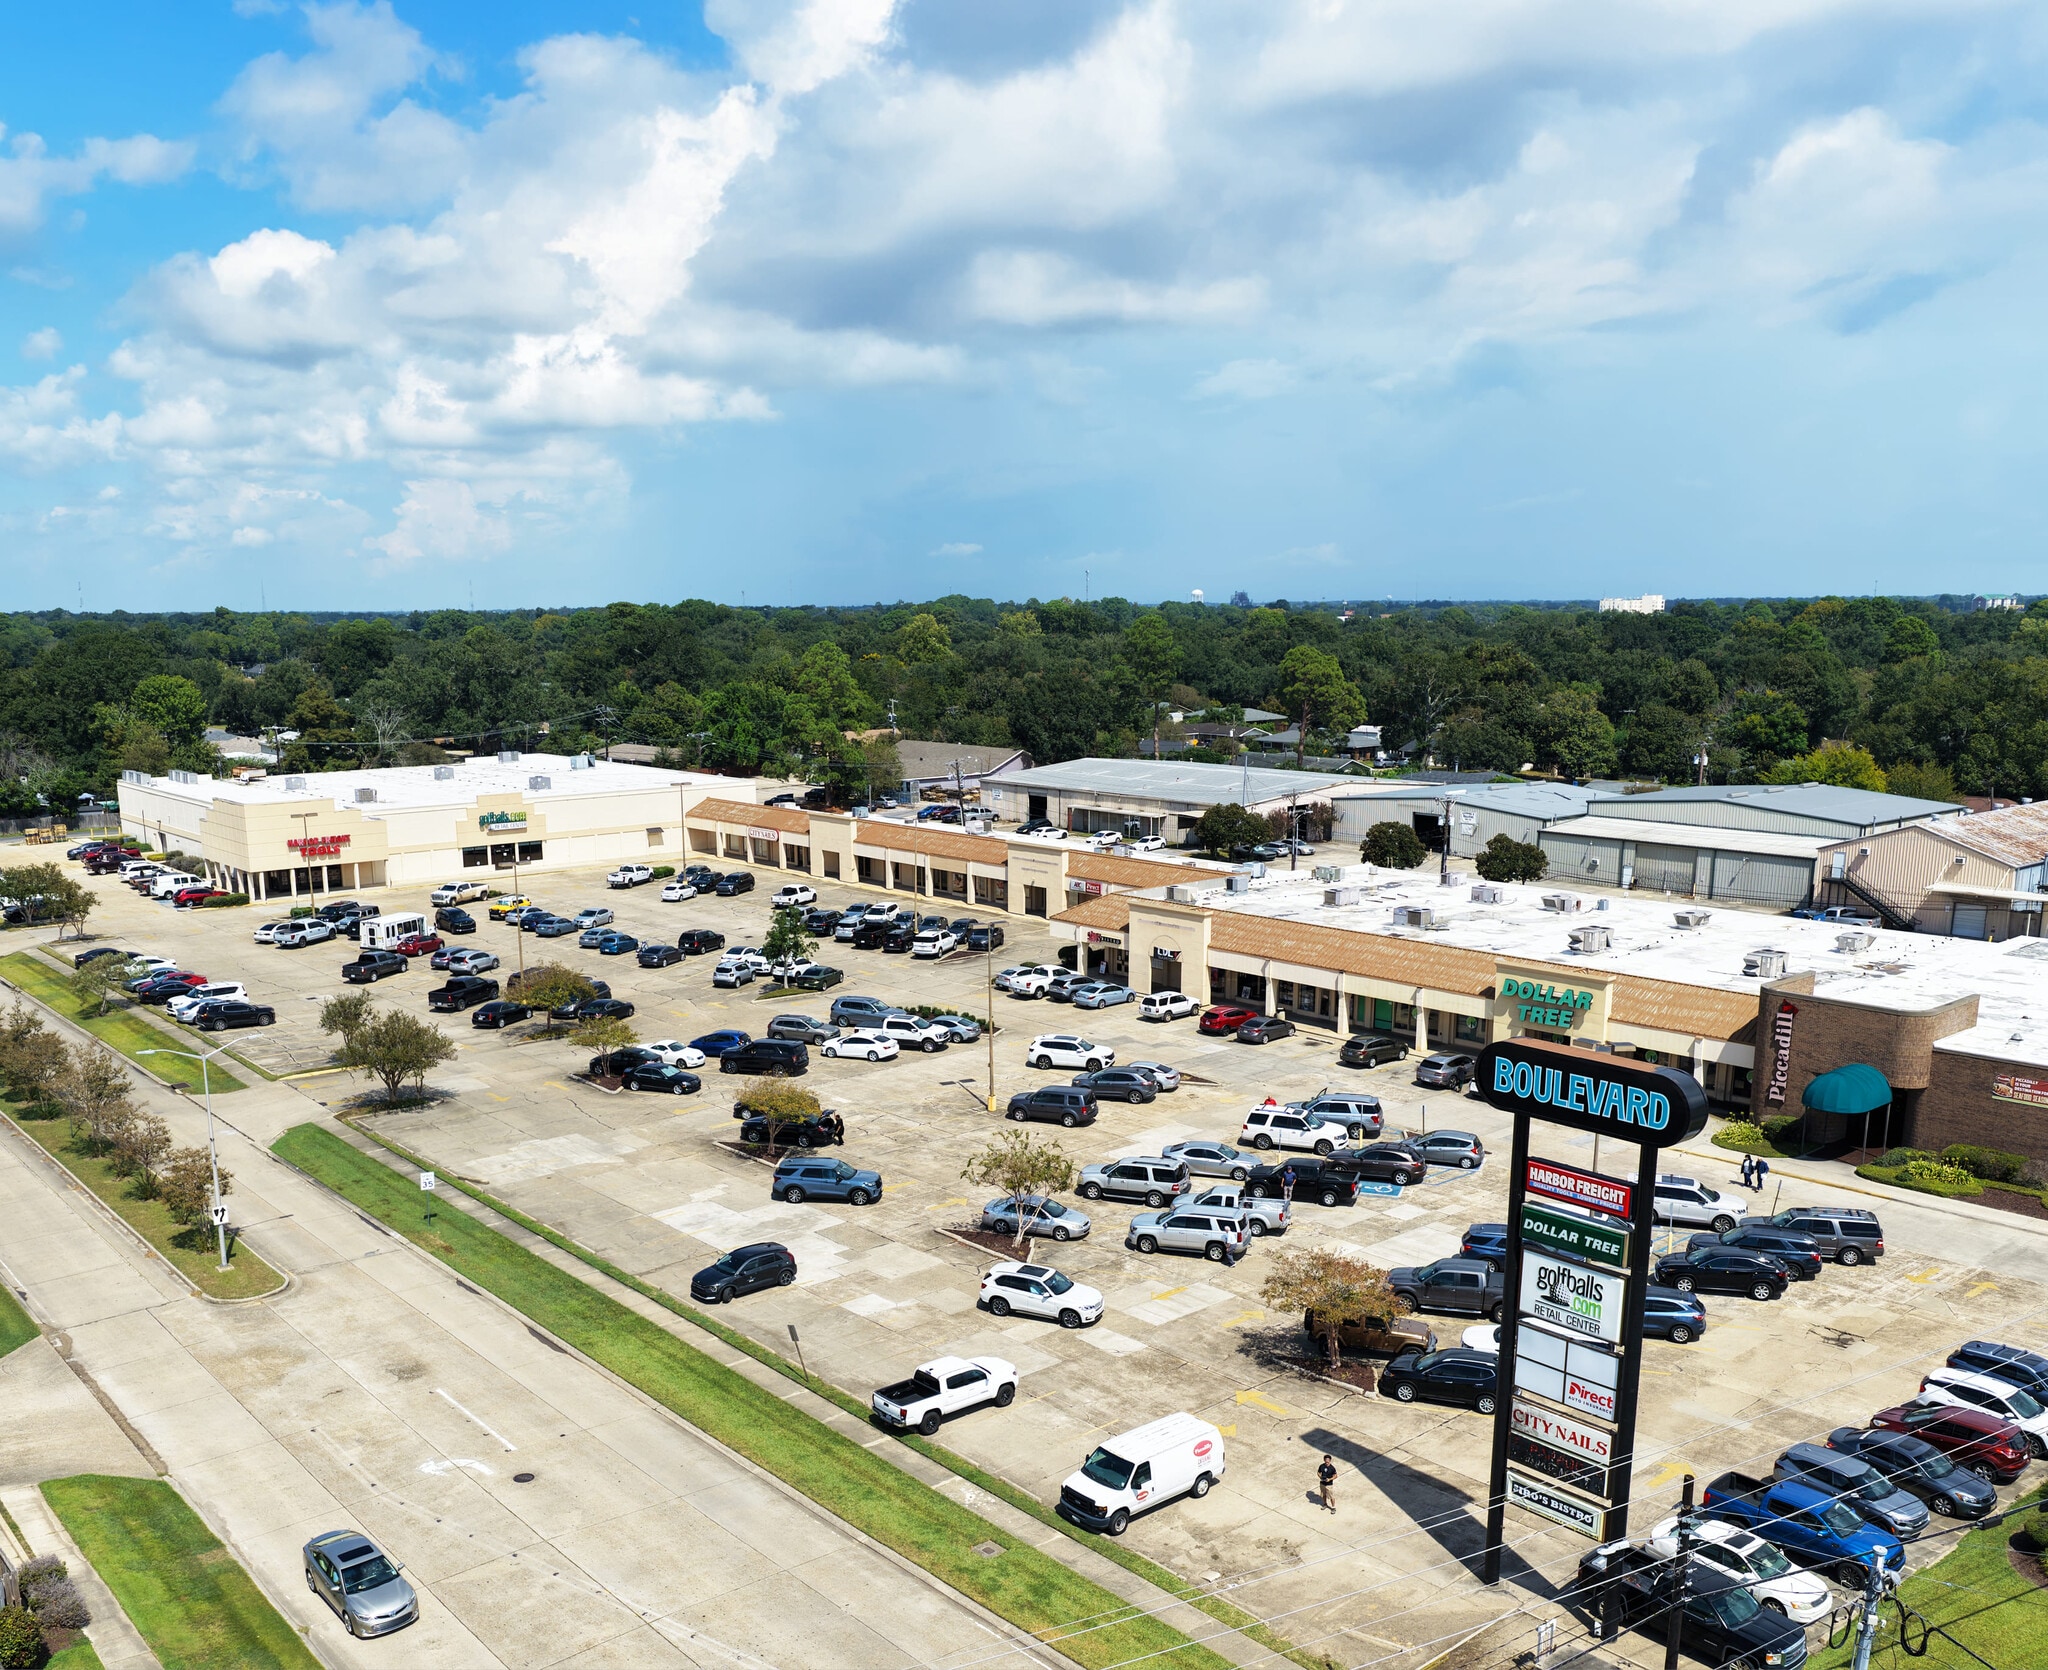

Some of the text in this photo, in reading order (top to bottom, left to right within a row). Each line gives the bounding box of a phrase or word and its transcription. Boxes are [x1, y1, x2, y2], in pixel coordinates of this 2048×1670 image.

[287, 837, 318, 848] HARBOR
[300, 844, 341, 857] TOOLS
[1502, 978, 1593, 1011] DOLLAR
[1517, 1004, 1573, 1028] TREE
[1493, 1056, 1670, 1131] BOULEVARD
[1529, 1166, 1625, 1205] HARBOR FREIGHT
[1533, 1181, 1619, 1210] QUALITY TOOLS LOWEST PRICES
[1523, 1218, 1620, 1256] DOLLAR TREE
[1536, 1265, 1604, 1302] golfballs
[1534, 1303, 1600, 1335] RETAIL CENTER
[1570, 1296, 1602, 1319] .com
[1568, 1395, 1612, 1414] AUTO INSURANCE
[1569, 1382, 1614, 1409] Direct
[1512, 1409, 1608, 1456] CITY NAILS
[1551, 1499, 1592, 1524] BISTRO
